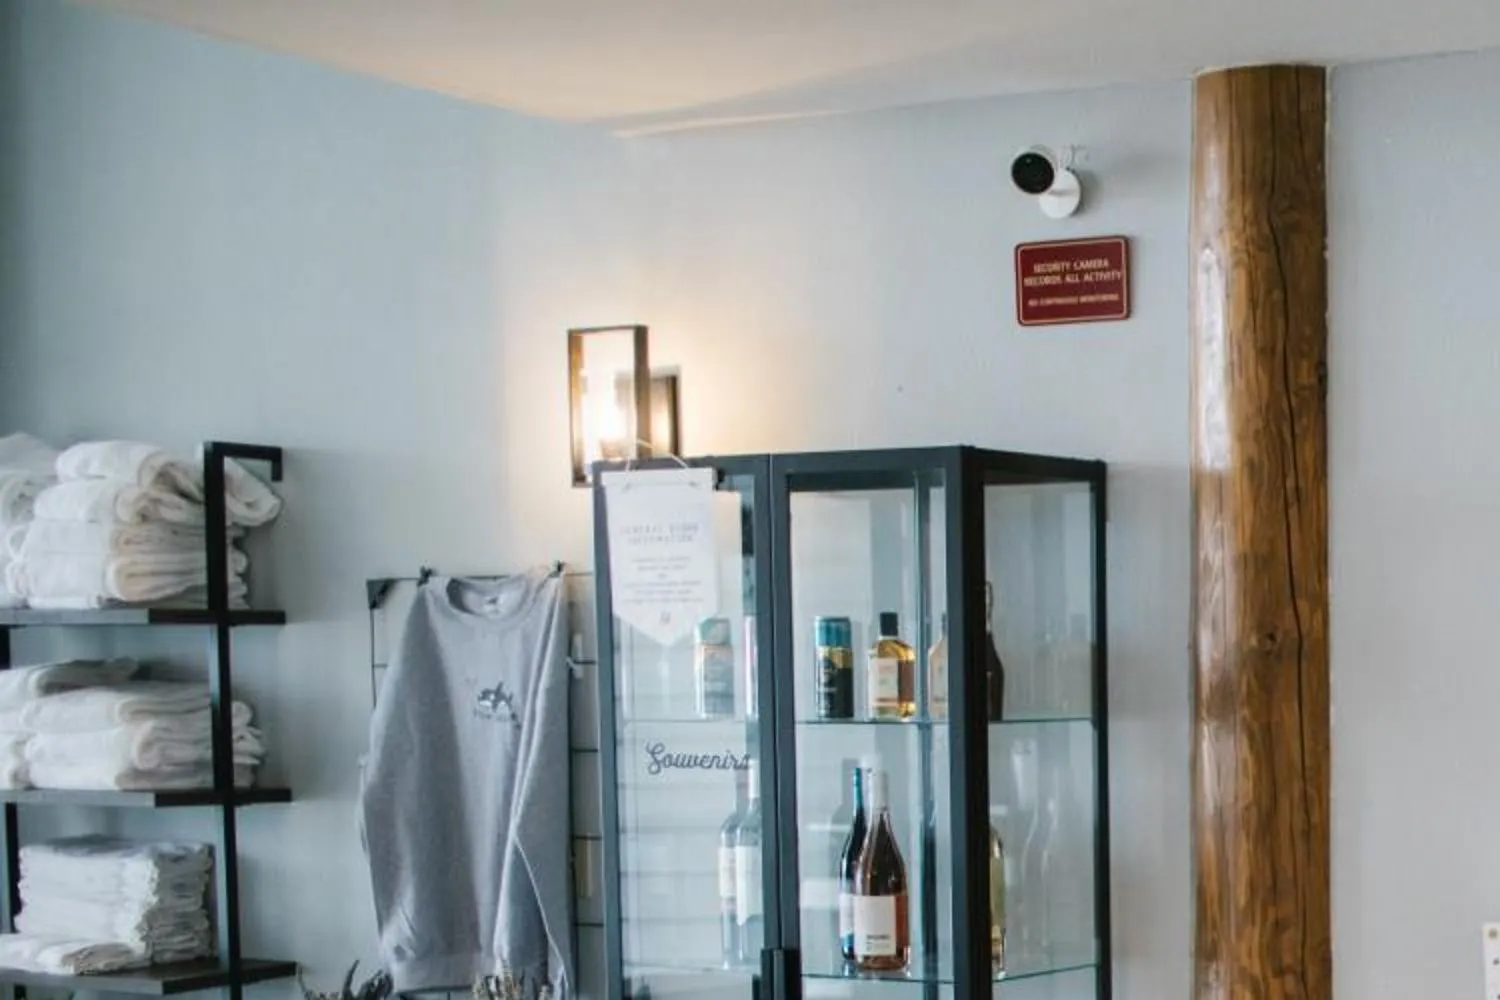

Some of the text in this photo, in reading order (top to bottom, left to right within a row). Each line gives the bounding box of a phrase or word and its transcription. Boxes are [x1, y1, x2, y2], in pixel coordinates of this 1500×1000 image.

[1033, 257, 1110, 274] SECURITY CAMERA
[1064, 272, 1081, 283] ALL
[1083, 269, 1122, 283] ACTIVITY
[645, 740, 752, 775] Souvenirs
